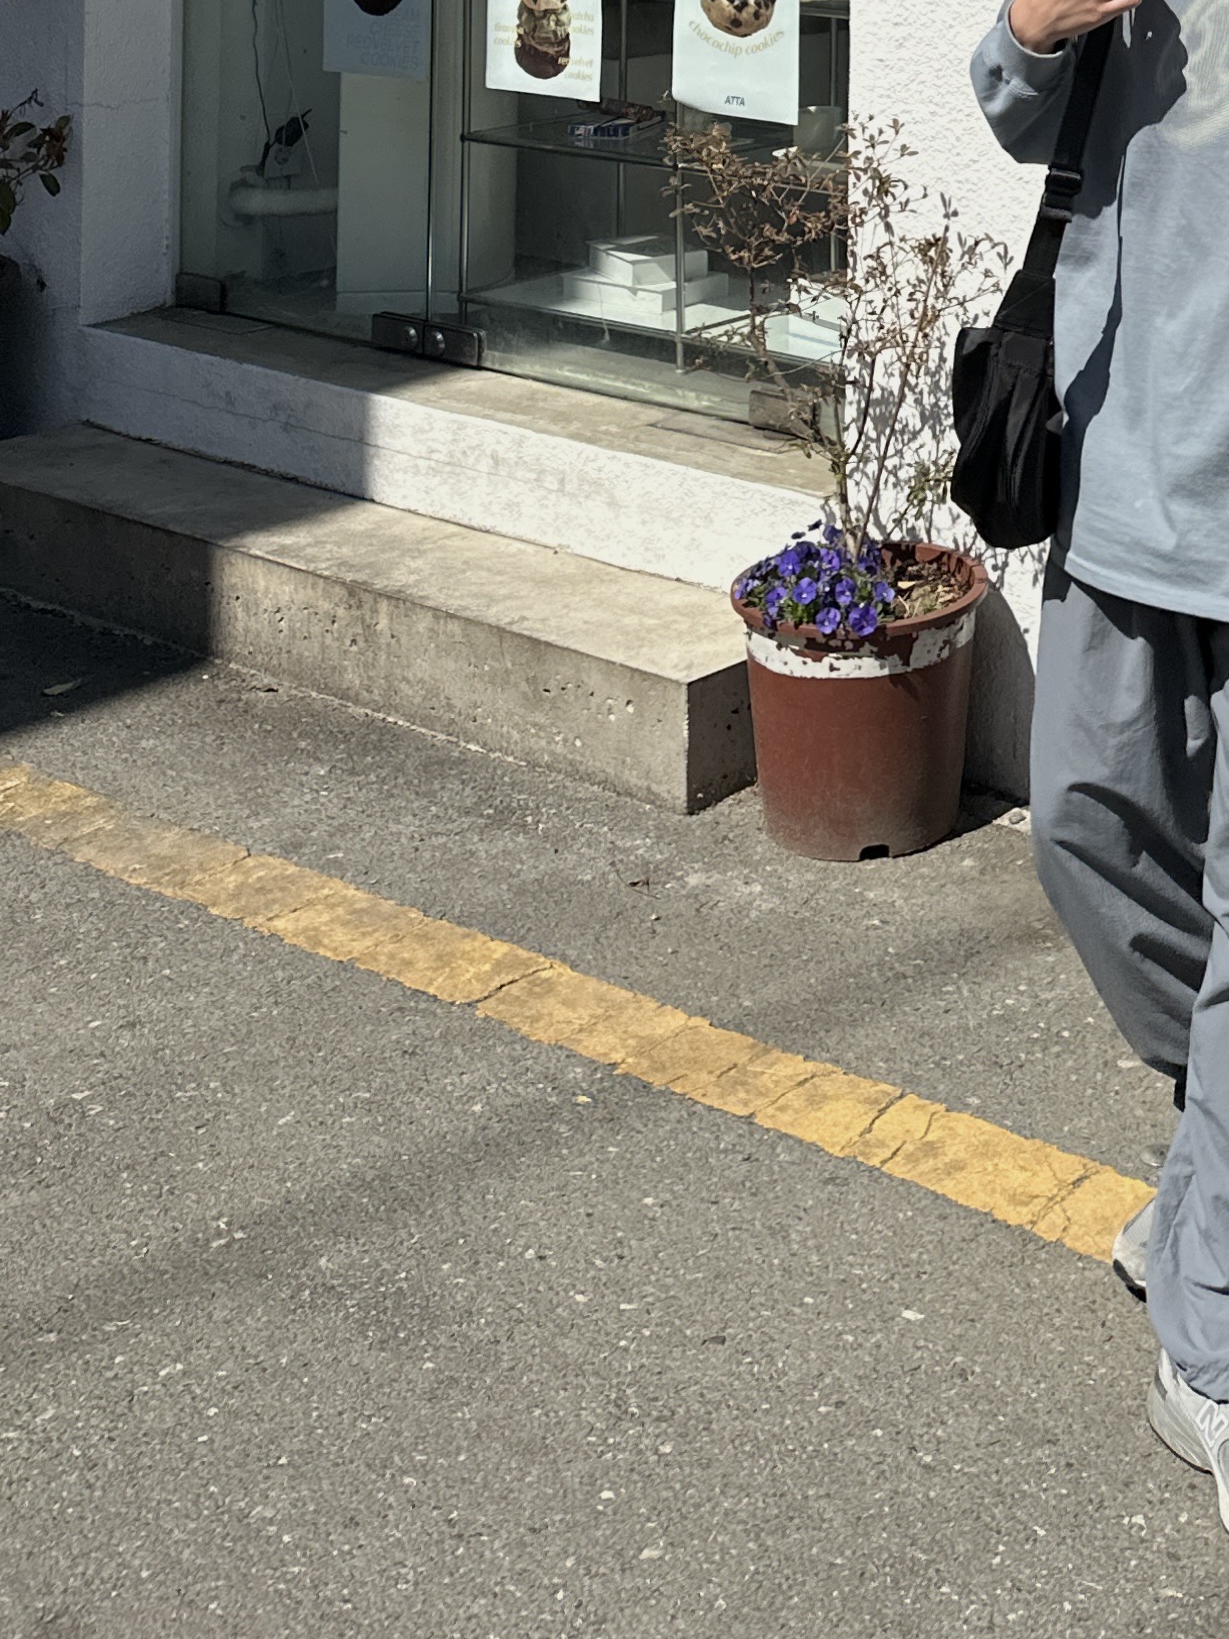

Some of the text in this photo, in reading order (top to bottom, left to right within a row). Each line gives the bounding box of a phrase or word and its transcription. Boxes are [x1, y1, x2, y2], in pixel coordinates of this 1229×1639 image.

[688, 20, 785, 59] chocochip cookies
[724, 95, 746, 107] ATTA
